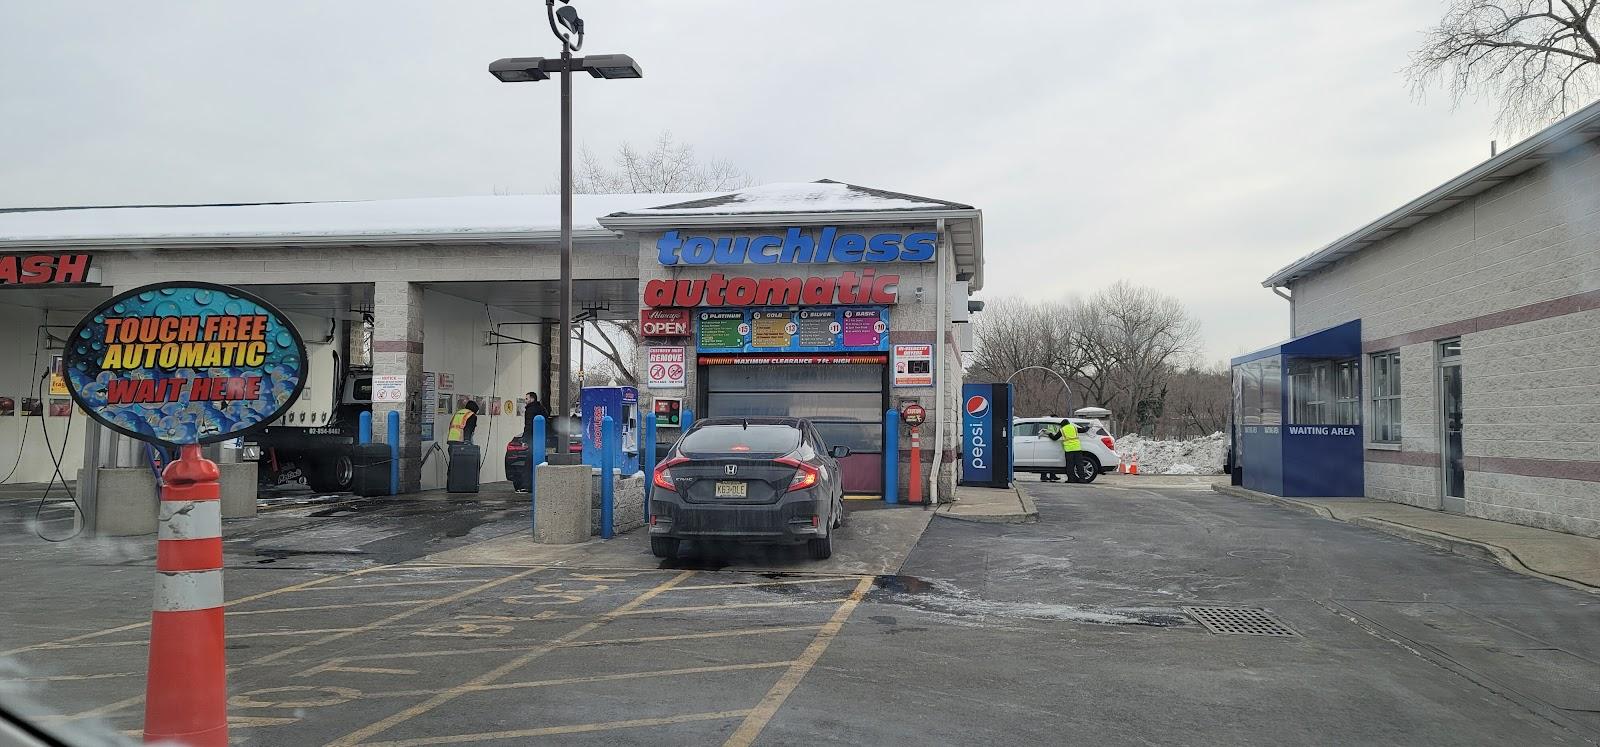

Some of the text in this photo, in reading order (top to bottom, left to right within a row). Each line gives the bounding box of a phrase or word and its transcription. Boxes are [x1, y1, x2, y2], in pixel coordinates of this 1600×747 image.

[656, 227, 937, 266] touchless
[643, 268, 899, 307] automatic
[104, 315, 268, 344] TOUCH FREE
[643, 322, 687, 334] OPEN
[648, 311, 681, 322] Always
[101, 341, 267, 370] AUTOMATIC
[650, 354, 683, 362] REMOVE
[107, 376, 262, 405] WAIT HERE
[593, 406, 604, 449] SPOTLESS
[1289, 427, 1329, 435] WAITING
[1330, 427, 1356, 436] AREA
[969, 422, 987, 469] pepsi
